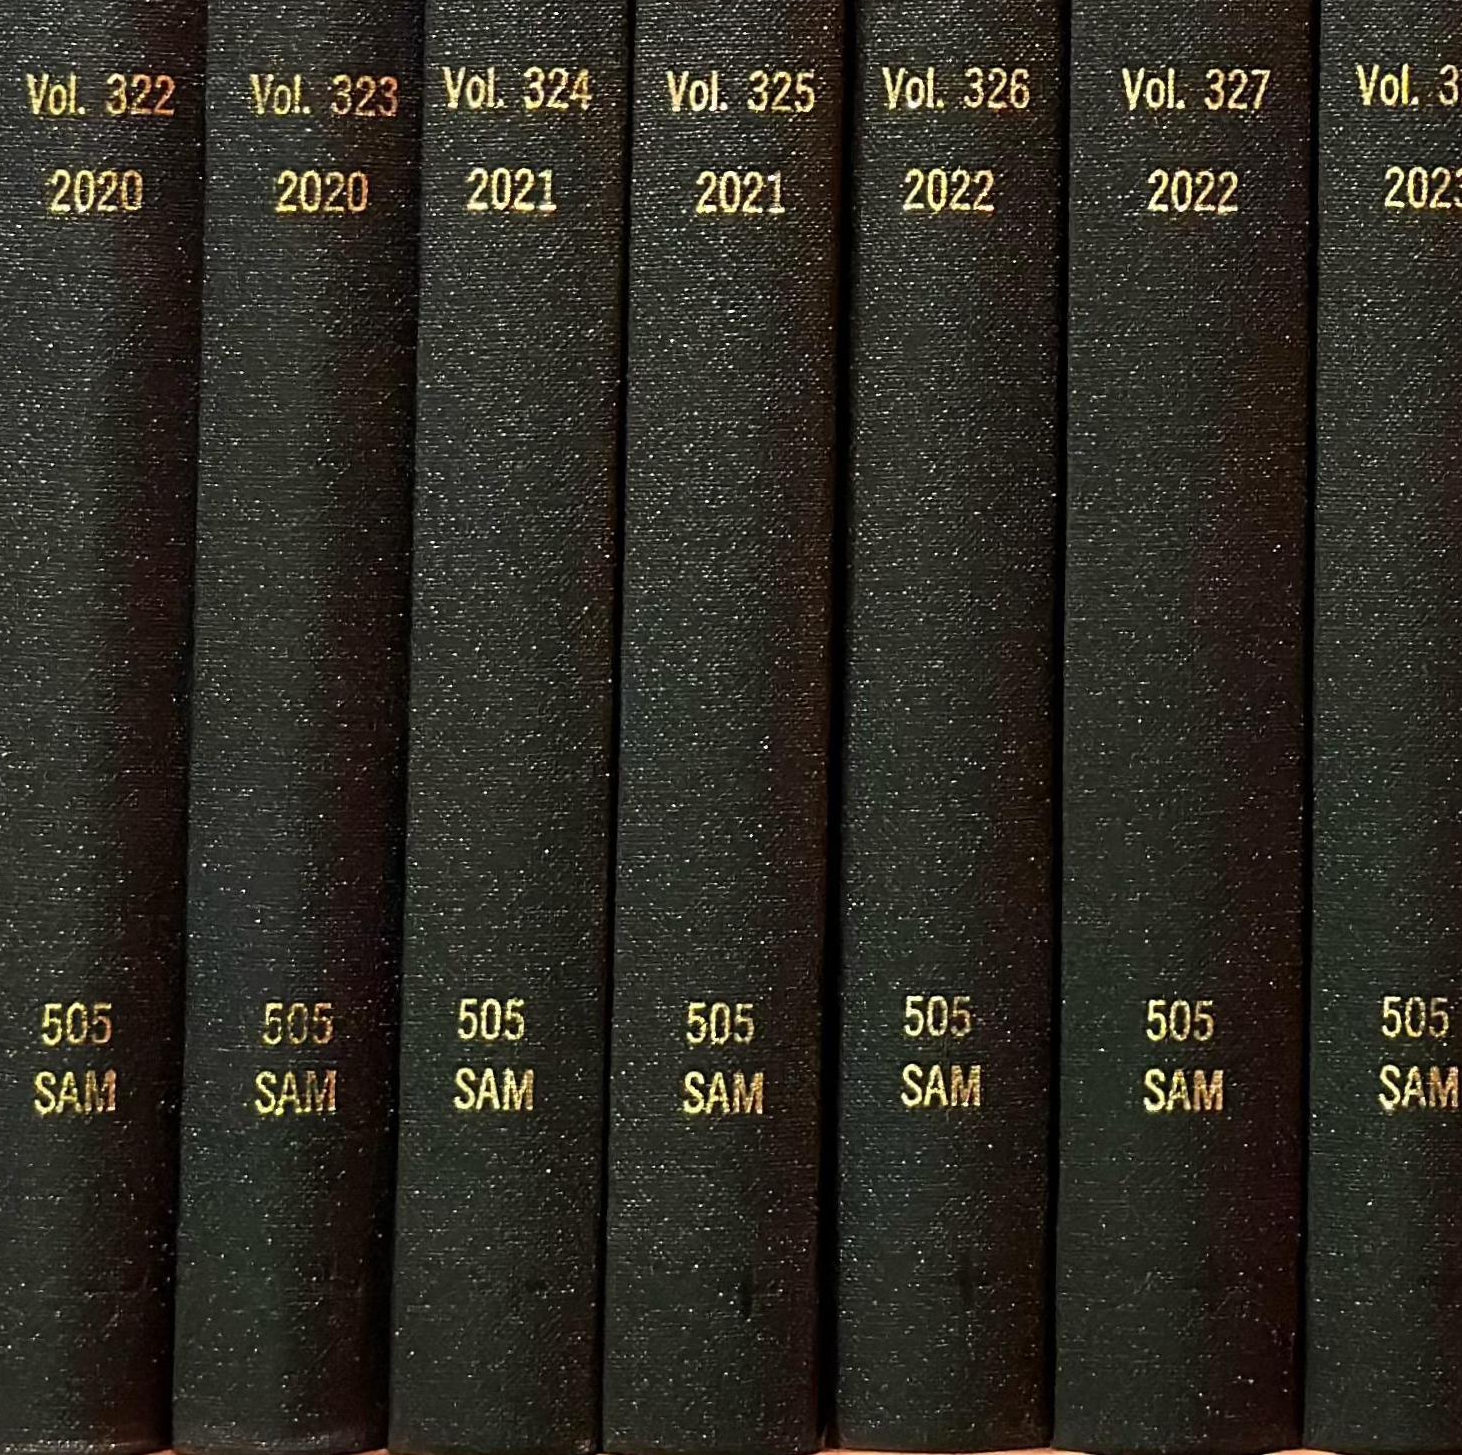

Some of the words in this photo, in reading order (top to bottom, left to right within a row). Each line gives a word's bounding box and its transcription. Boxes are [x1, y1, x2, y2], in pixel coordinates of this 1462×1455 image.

[250, 74, 311, 116] Vol.
[333, 76, 398, 116] 323
[666, 72, 729, 113] Vol.
[748, 71, 817, 114] 325
[1123, 69, 1185, 111] Vol.
[1205, 69, 1271, 110] 327
[276, 170, 369, 214] 2020
[697, 172, 781, 216] 2021
[1151, 170, 1239, 215] 2022
[263, 1003, 334, 1045] 505
[687, 1003, 755, 1045] 505
[1148, 1000, 1214, 1042] 505
[255, 1070, 337, 1117] SAM
[683, 1072, 764, 1116] SAM
[1145, 1070, 1224, 1113] SAM
